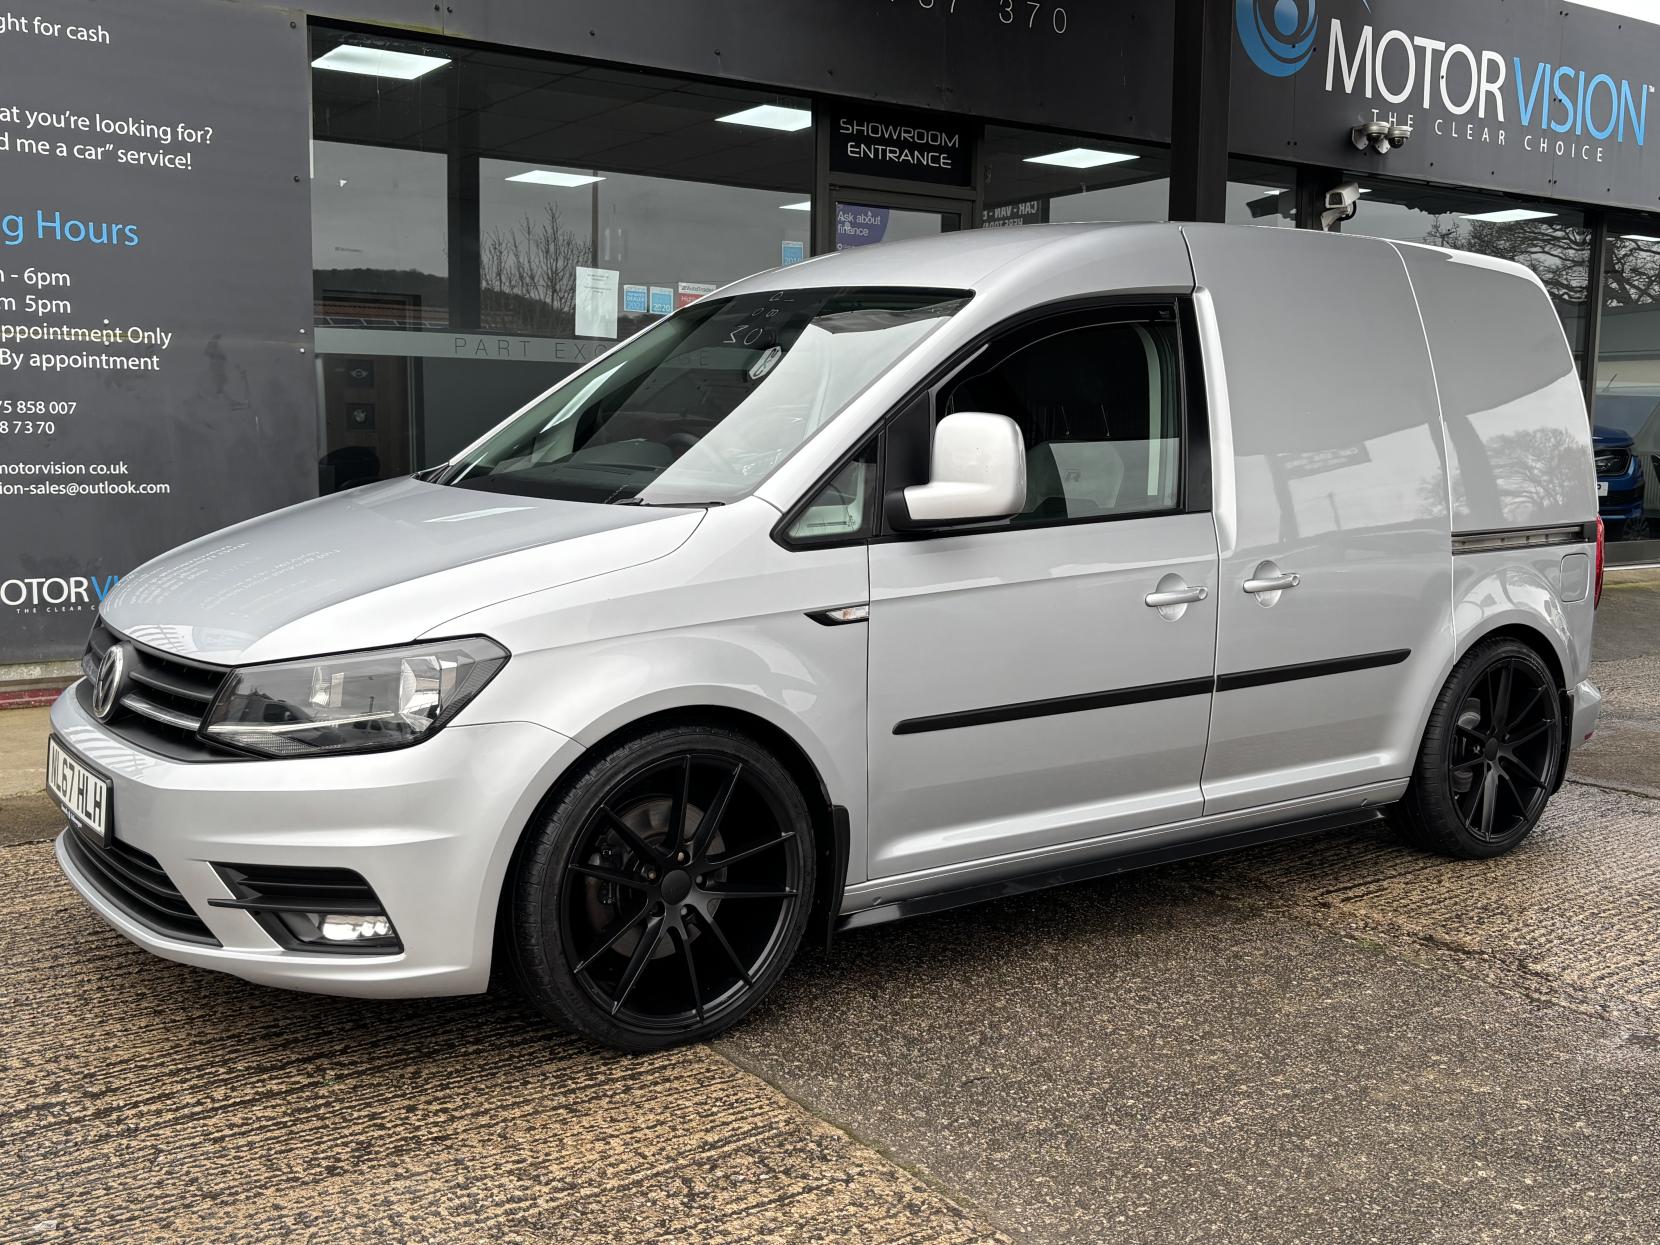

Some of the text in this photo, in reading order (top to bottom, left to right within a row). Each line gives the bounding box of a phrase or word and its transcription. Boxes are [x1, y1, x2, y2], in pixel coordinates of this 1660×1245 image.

[33, 17, 61, 37] for
[67, 25, 110, 44] cash
[1326, 19, 1506, 122] MOTOR
[25, 111, 90, 131] you're
[96, 114, 172, 143] looking
[177, 124, 213, 144] for?
[840, 119, 959, 148] SHOWROOM
[1435, 119, 1506, 146] CLEAR
[1525, 136, 1604, 162] CHOICE
[17, 138, 50, 154] me
[56, 143, 68, 156] a
[118, 148, 192, 170] service!
[848, 143, 952, 168] ENTRANCE
[37, 210, 139, 246] Hours
[838, 211, 881, 225] Ask about
[838, 223, 869, 236] finance
[24, 267, 71, 289] 6pm
[25, 295, 71, 316] 5pm
[127, 327, 172, 349] Only
[455, 337, 531, 358] PART
[0, 348, 160, 372] By appointment
[17, 401, 46, 414] 858
[49, 401, 77, 415] 007
[46, 604, 82, 613] CLEAR
[50, 744, 75, 803] NL67
[77, 768, 103, 828] HLH
